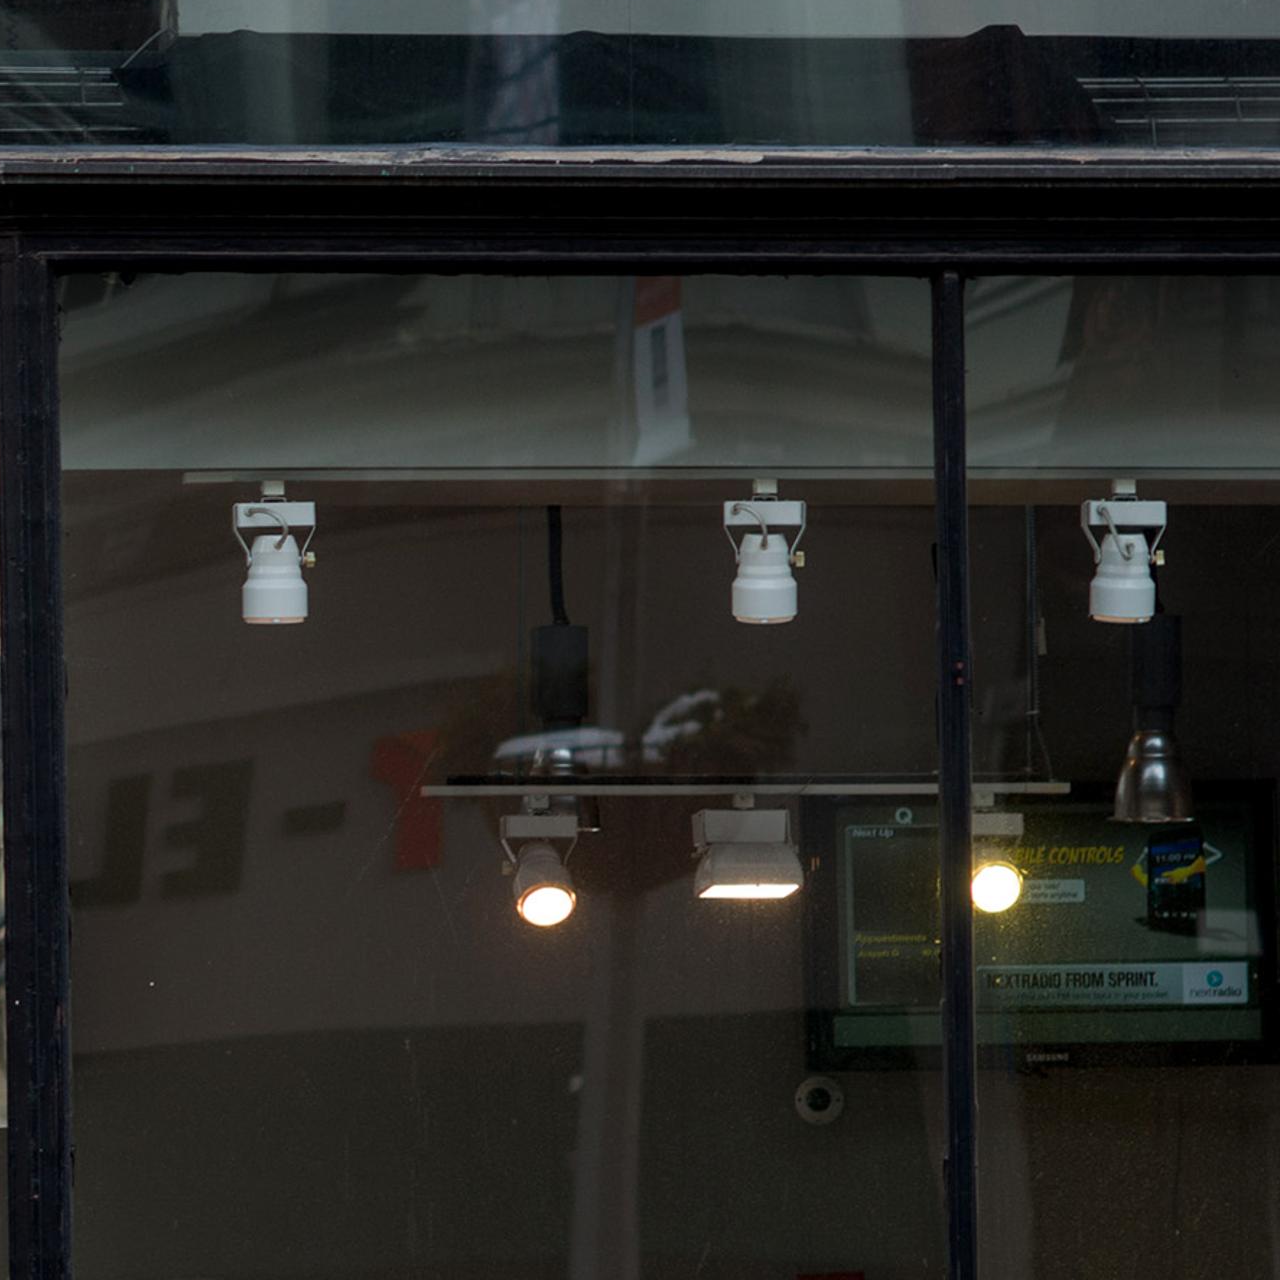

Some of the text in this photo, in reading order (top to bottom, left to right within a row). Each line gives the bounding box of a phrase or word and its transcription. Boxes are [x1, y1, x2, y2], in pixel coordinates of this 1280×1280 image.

[1048, 845, 1125, 865] CONTROLS
[1065, 972, 1105, 989] FROM
[1107, 971, 1159, 988] SPRINT.
